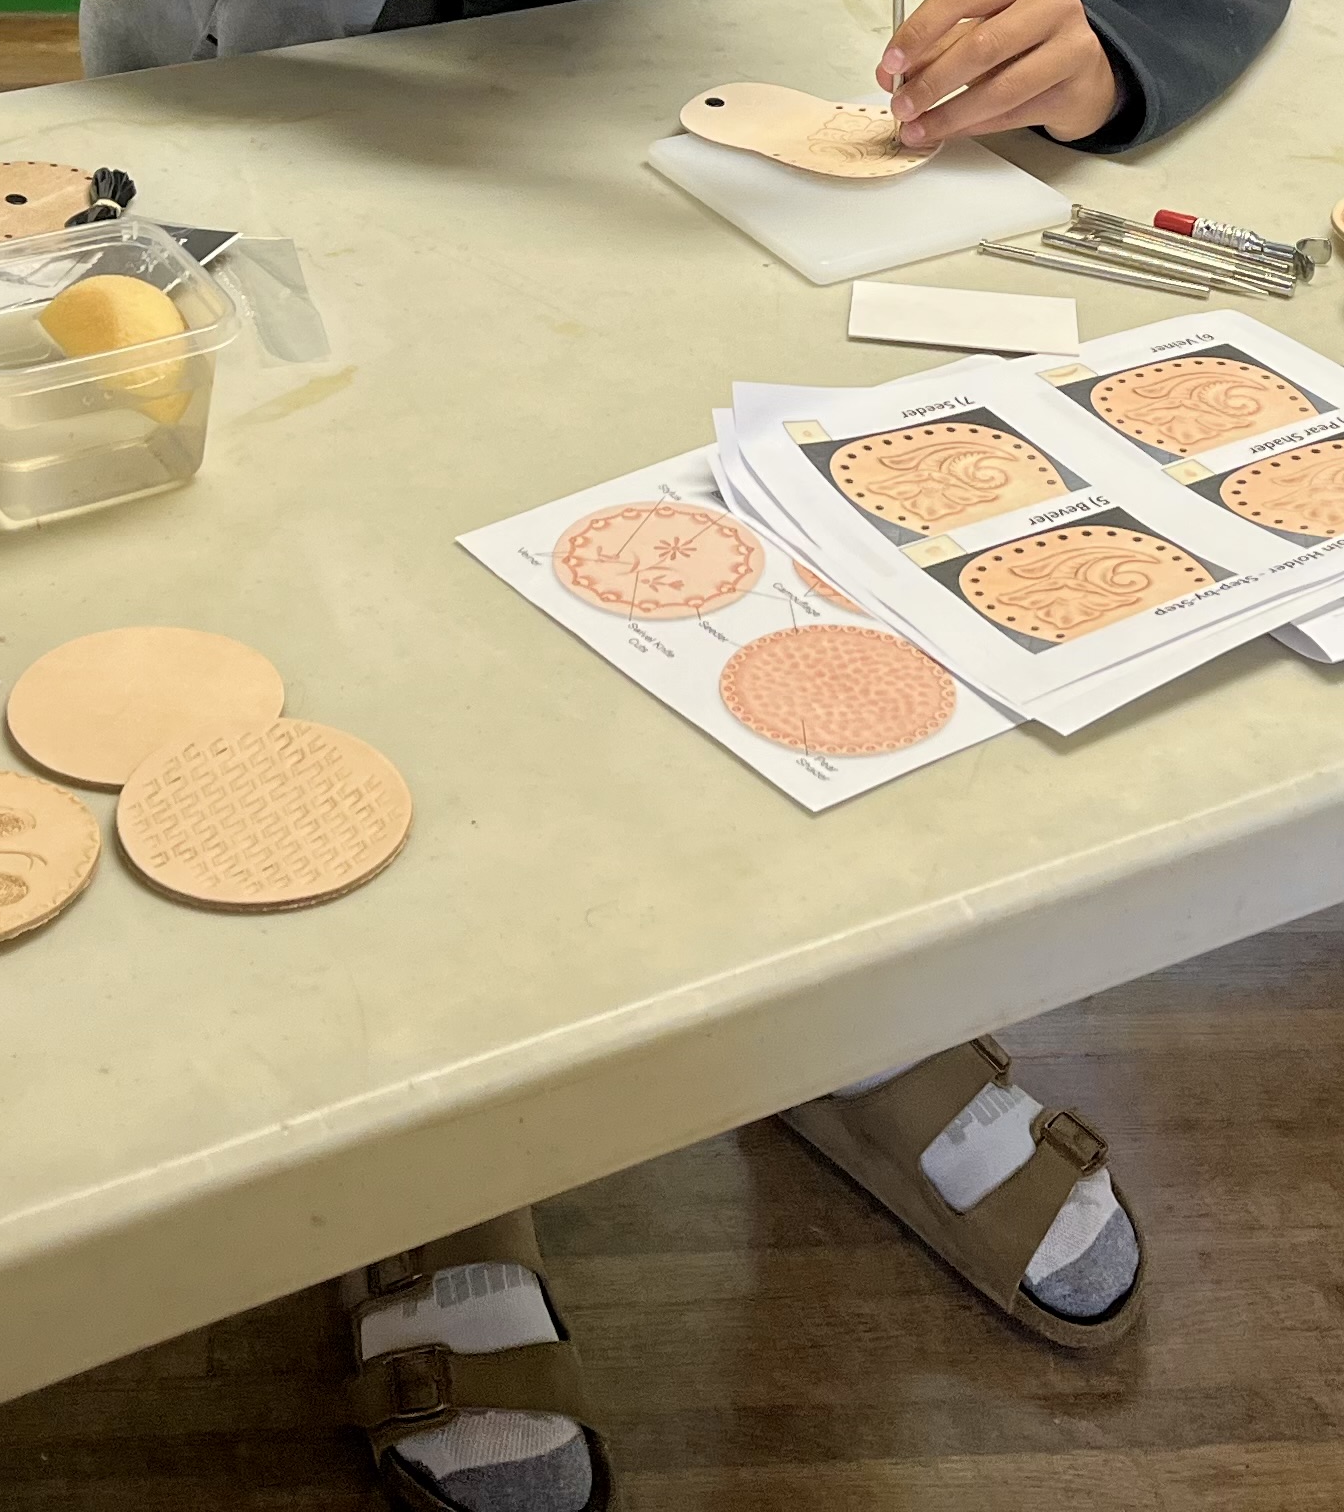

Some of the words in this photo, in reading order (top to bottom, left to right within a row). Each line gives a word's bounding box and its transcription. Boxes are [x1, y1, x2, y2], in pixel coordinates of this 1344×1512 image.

[1150, 337, 1197, 354] Veiner
[902, 401, 955, 419] Seeder
[1304, 422, 1337, 438] Pear
[1250, 434, 1304, 454] Shader
[1028, 500, 1091, 526] Beveler
[1268, 550, 1324, 574] Holder
